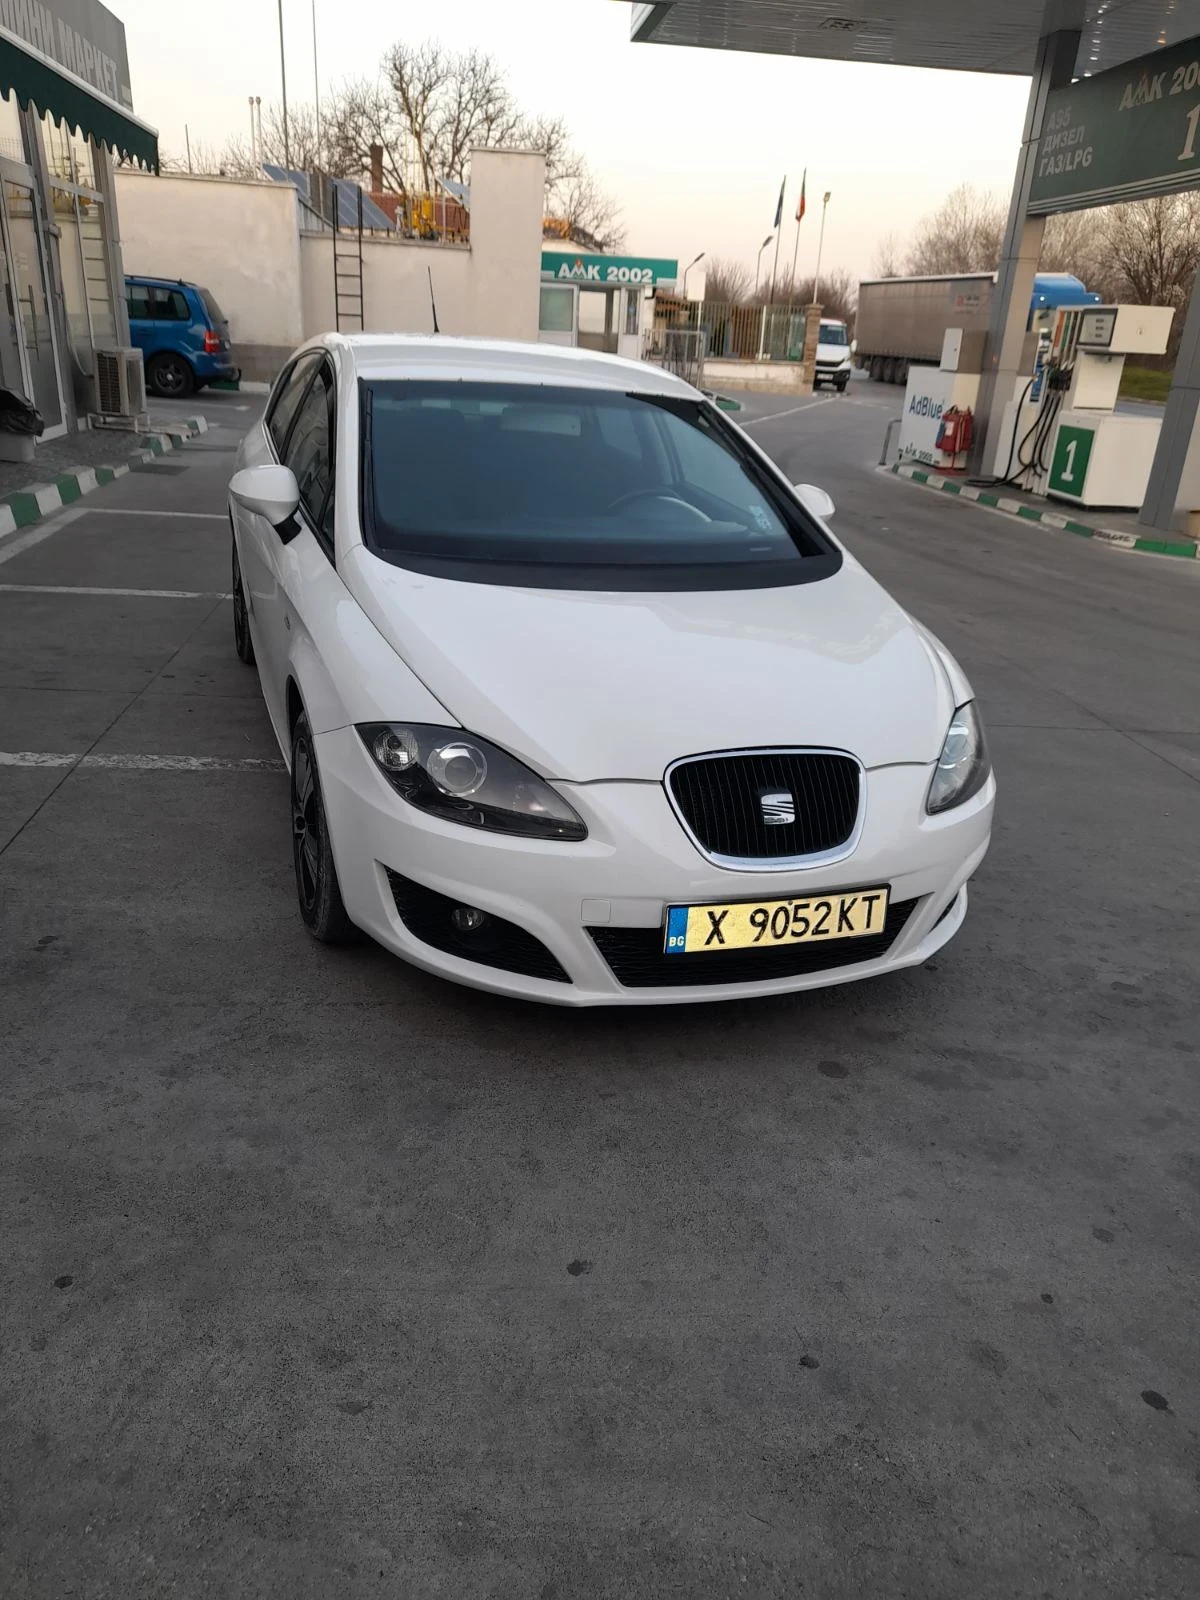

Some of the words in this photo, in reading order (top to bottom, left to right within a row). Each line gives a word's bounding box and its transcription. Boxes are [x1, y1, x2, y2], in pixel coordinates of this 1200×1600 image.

[1169, 61, 1200, 95] 20
[1042, 125, 1086, 156] ДИЗЕЛ
[1177, 103, 1200, 161] 1
[1039, 146, 1093, 177] ГАЗ/LPG
[558, 261, 600, 279] АМК
[606, 266, 653, 283] 2002
[909, 395, 942, 419] AdBlue
[1060, 439, 1078, 482] 1
[704, 910, 729, 945] X
[750, 894, 880, 942] 9052KT
[669, 936, 684, 946] BG
